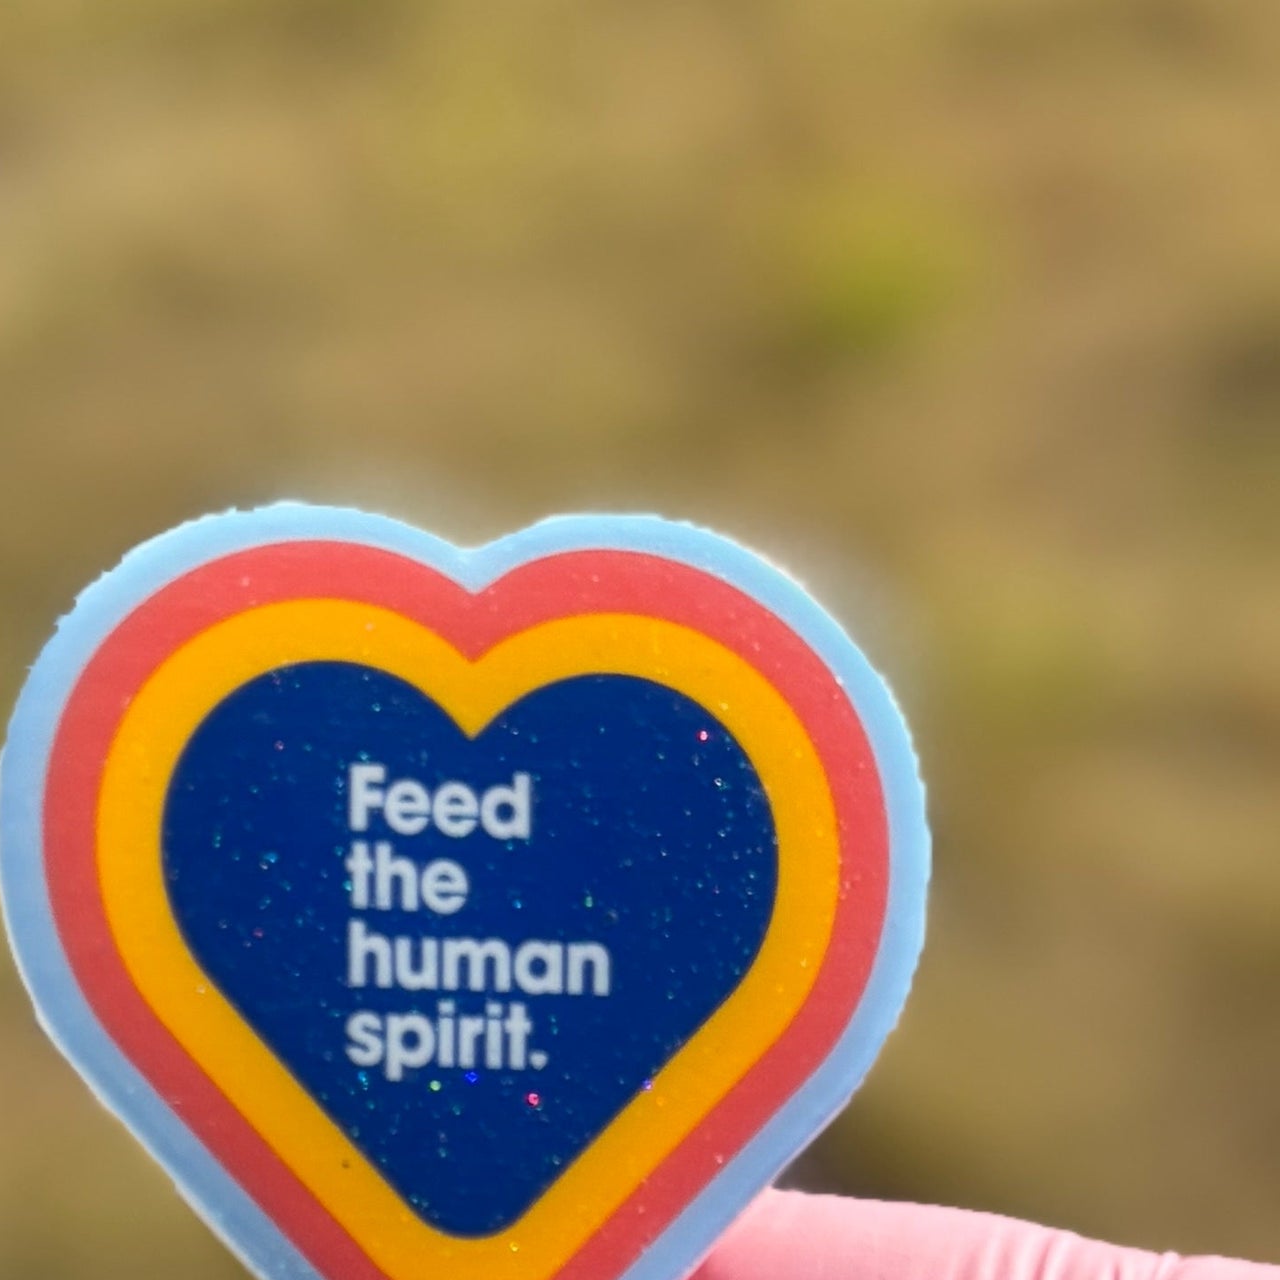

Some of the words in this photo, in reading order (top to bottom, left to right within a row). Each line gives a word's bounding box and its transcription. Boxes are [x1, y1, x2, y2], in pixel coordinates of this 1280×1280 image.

[348, 763, 531, 839] Feed
[345, 841, 468, 914] the
[347, 917, 610, 996] human
[345, 1000, 548, 1082] spirit.
